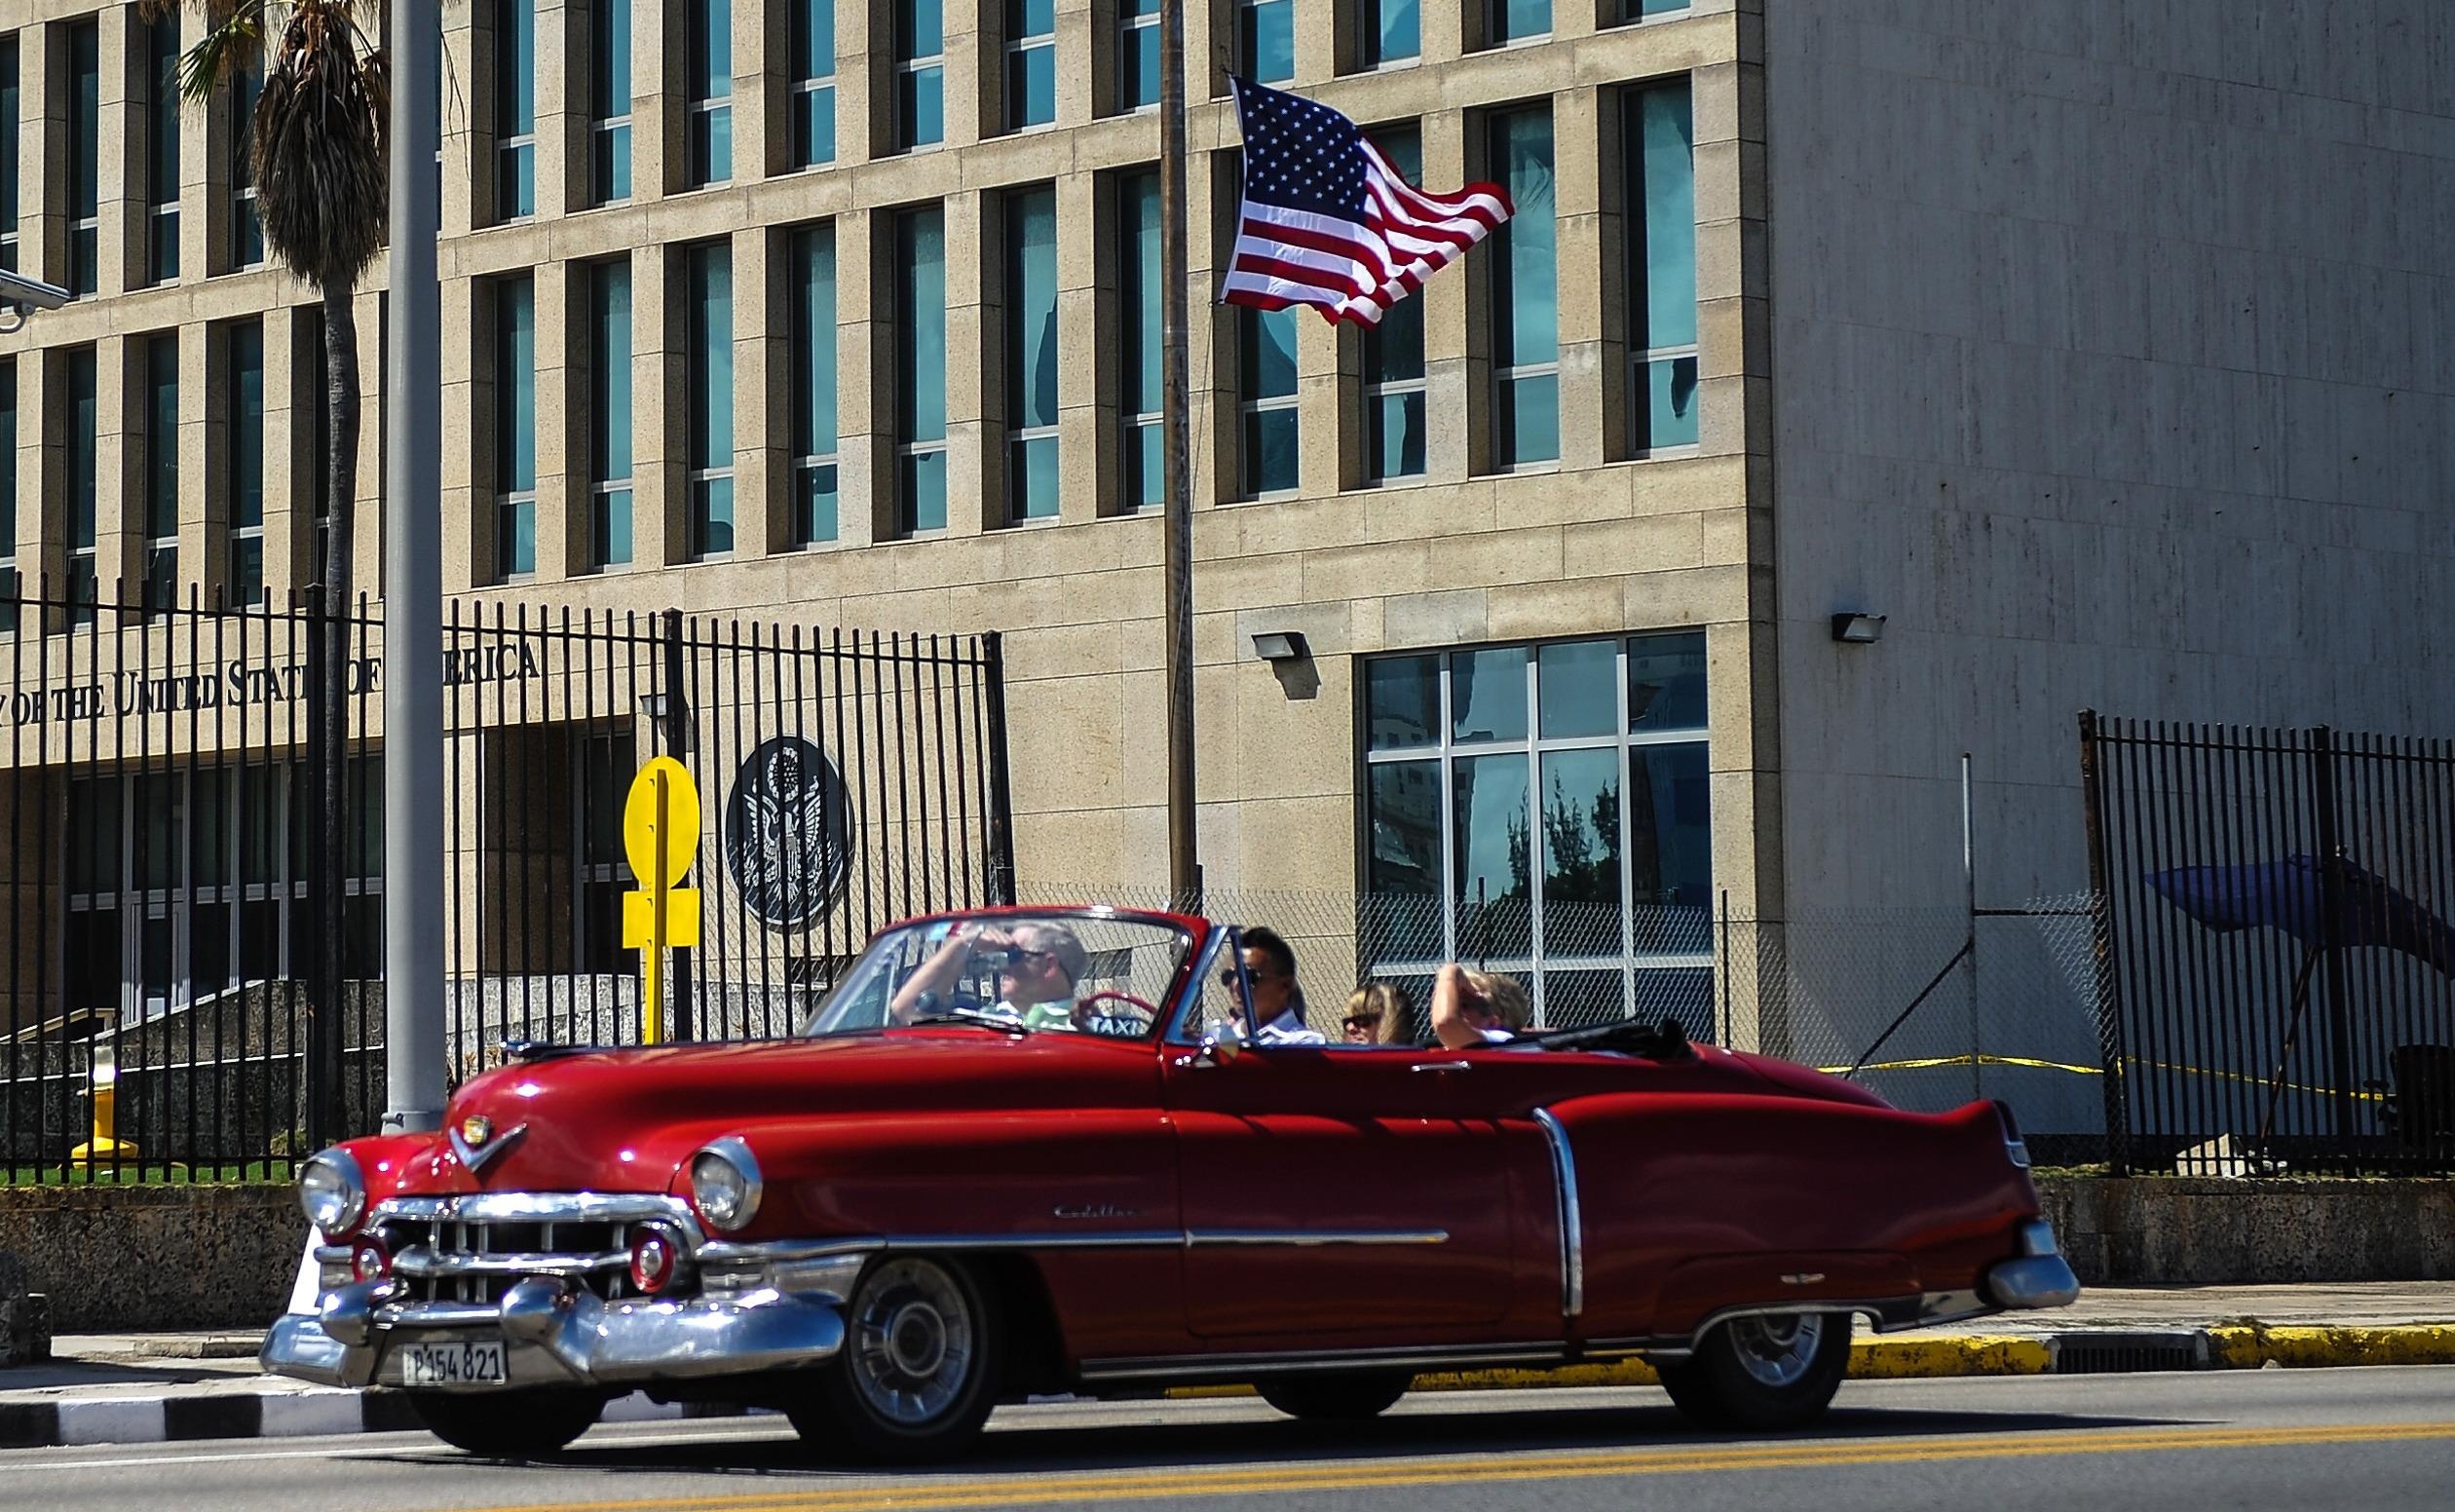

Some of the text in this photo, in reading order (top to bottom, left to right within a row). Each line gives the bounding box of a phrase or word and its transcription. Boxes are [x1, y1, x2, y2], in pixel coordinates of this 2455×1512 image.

[12, 692, 46, 726] OF
[51, 684, 104, 723] THE
[228, 661, 309, 706] STAT
[442, 642, 541, 685] ERICA
[1090, 1015, 1138, 1036] TAXI
[414, 1348, 459, 1381] P154
[463, 1346, 503, 1380] 821
